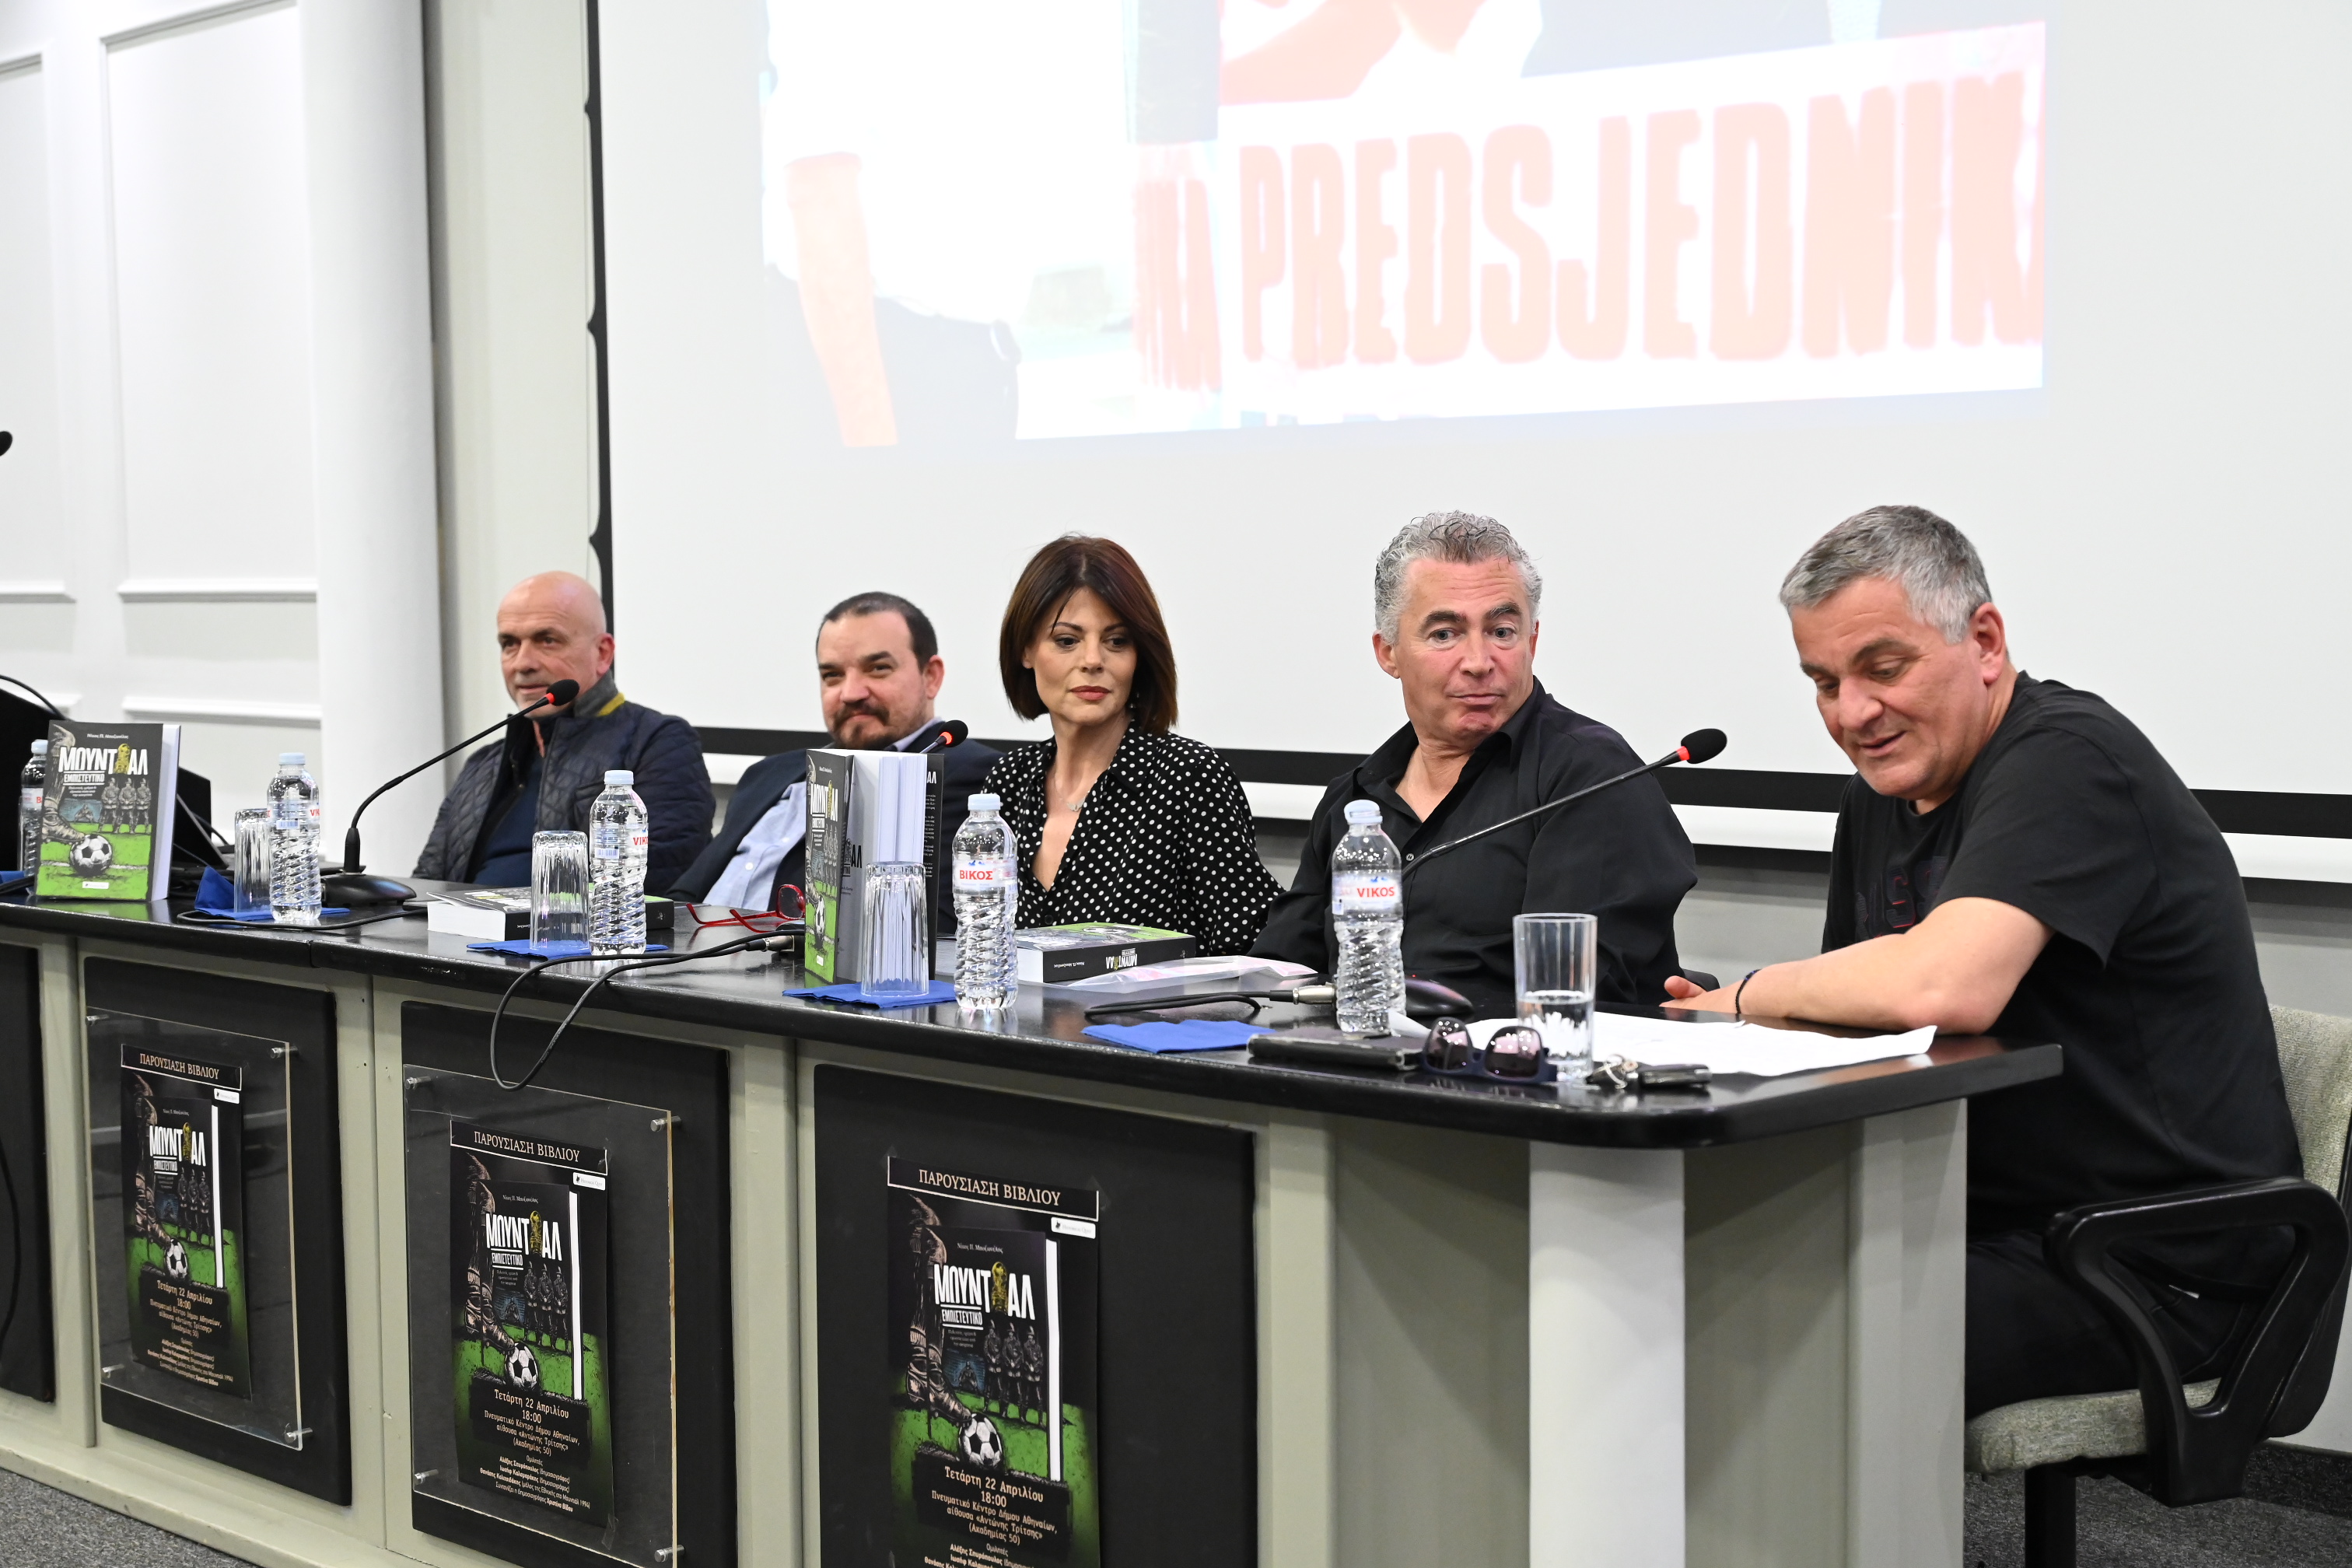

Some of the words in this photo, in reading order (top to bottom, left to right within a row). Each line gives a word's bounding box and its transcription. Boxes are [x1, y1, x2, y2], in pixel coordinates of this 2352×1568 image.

[959, 870, 993, 880] ΒΙΚΟΣ
[1356, 887, 1395, 898] VIKOS
[140, 1053, 186, 1073] ΠΑΡΟΥΣΙΑΣΗ
[187, 1064, 219, 1080] ΒΙΒΛΙΟΥ
[474, 1131, 534, 1154] ΠΑΡΟΥΣΙΑΣΗ
[537, 1143, 580, 1162] ΒΙΒΛΙΟΥ
[919, 1169, 999, 1198] ΠΑΡΟΥΣΙΑΣΗ
[1003, 1184, 1061, 1206] ΒΙΒΛΙΟΥ
[177, 1297, 191, 1310] 18:00
[178, 1287, 185, 1297] 22
[187, 1290, 213, 1305] Απριλίου
[494, 1389, 523, 1408] Τετάρτη
[525, 1398, 534, 1409] 22
[537, 1401, 569, 1419] Απριλίου
[522, 1409, 542, 1424] 18:00
[484, 1410, 515, 1426] Πνευματικό
[516, 1419, 534, 1432] Κέντρο
[535, 1425, 551, 1437] Δήμου
[552, 1430, 580, 1446] Αθηναίων,
[496, 1423, 517, 1436] αίθουσα
[513, 1437, 542, 1454] (Ακαδημίας
[543, 1447, 551, 1457] 50)
[944, 1465, 982, 1489] Τετάρτη
[985, 1476, 996, 1490] 22
[1000, 1480, 1044, 1503] Απριλίου
[981, 1490, 1007, 1508] 18:00
[932, 1490, 970, 1509] Πνευματικό
[972, 1501, 996, 1516] Κέντρο
[999, 1509, 1020, 1522] Δήμου
[1022, 1514, 1058, 1535] Αθηναίων,
[947, 1507, 974, 1521] αίθουσα
[976, 1514, 1009, 1531] «Αντώνης
[1010, 1522, 1043, 1540] Τρίτσης»
[968, 1522, 1007, 1542] (Ακαδημίας
[1009, 1534, 1020, 1545] 50)
[950, 1543, 968, 1556] Αλέξης
[986, 1543, 1009, 1557] Ομιλητές
